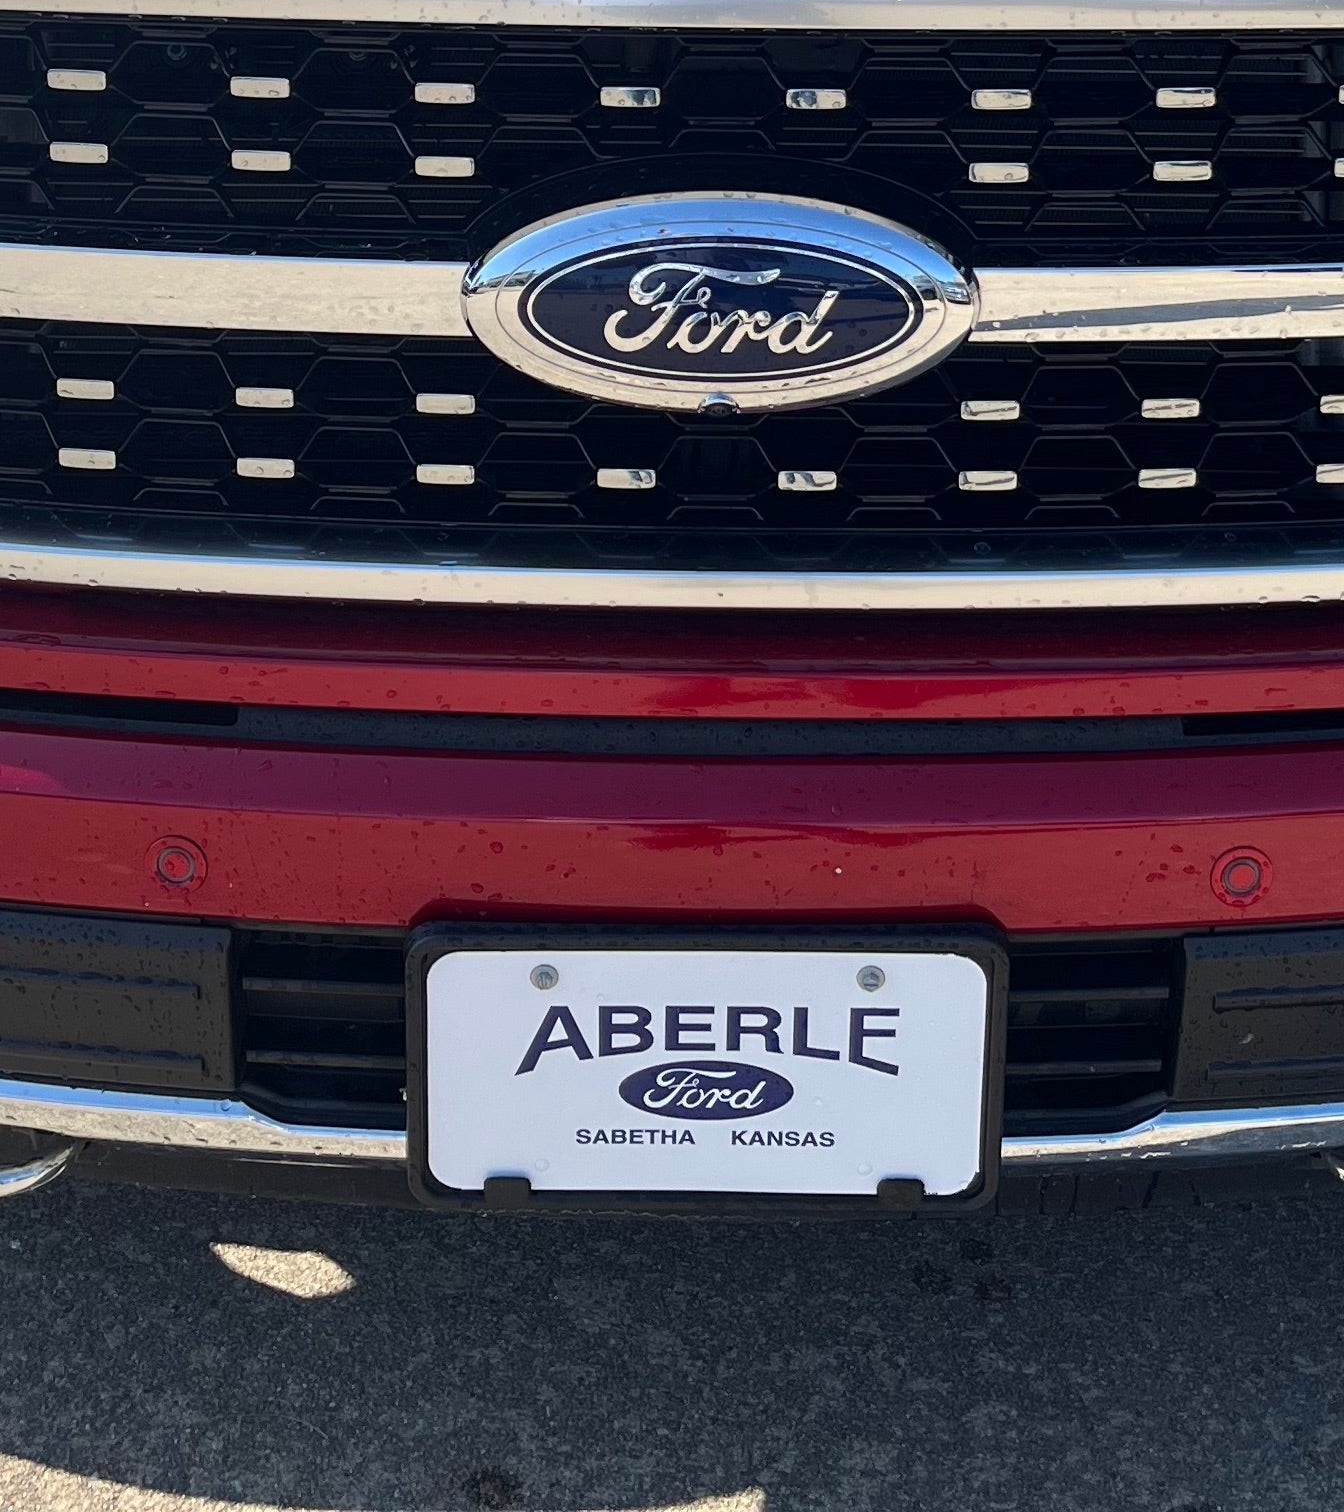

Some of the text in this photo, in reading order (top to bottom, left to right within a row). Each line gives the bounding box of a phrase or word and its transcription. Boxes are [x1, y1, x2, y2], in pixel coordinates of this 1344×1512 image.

[603, 262, 839, 354] Ford
[514, 1005, 900, 1077] ABERLE
[643, 1068, 766, 1109] Ford
[575, 1128, 835, 1148] SABETHA KANSAS
